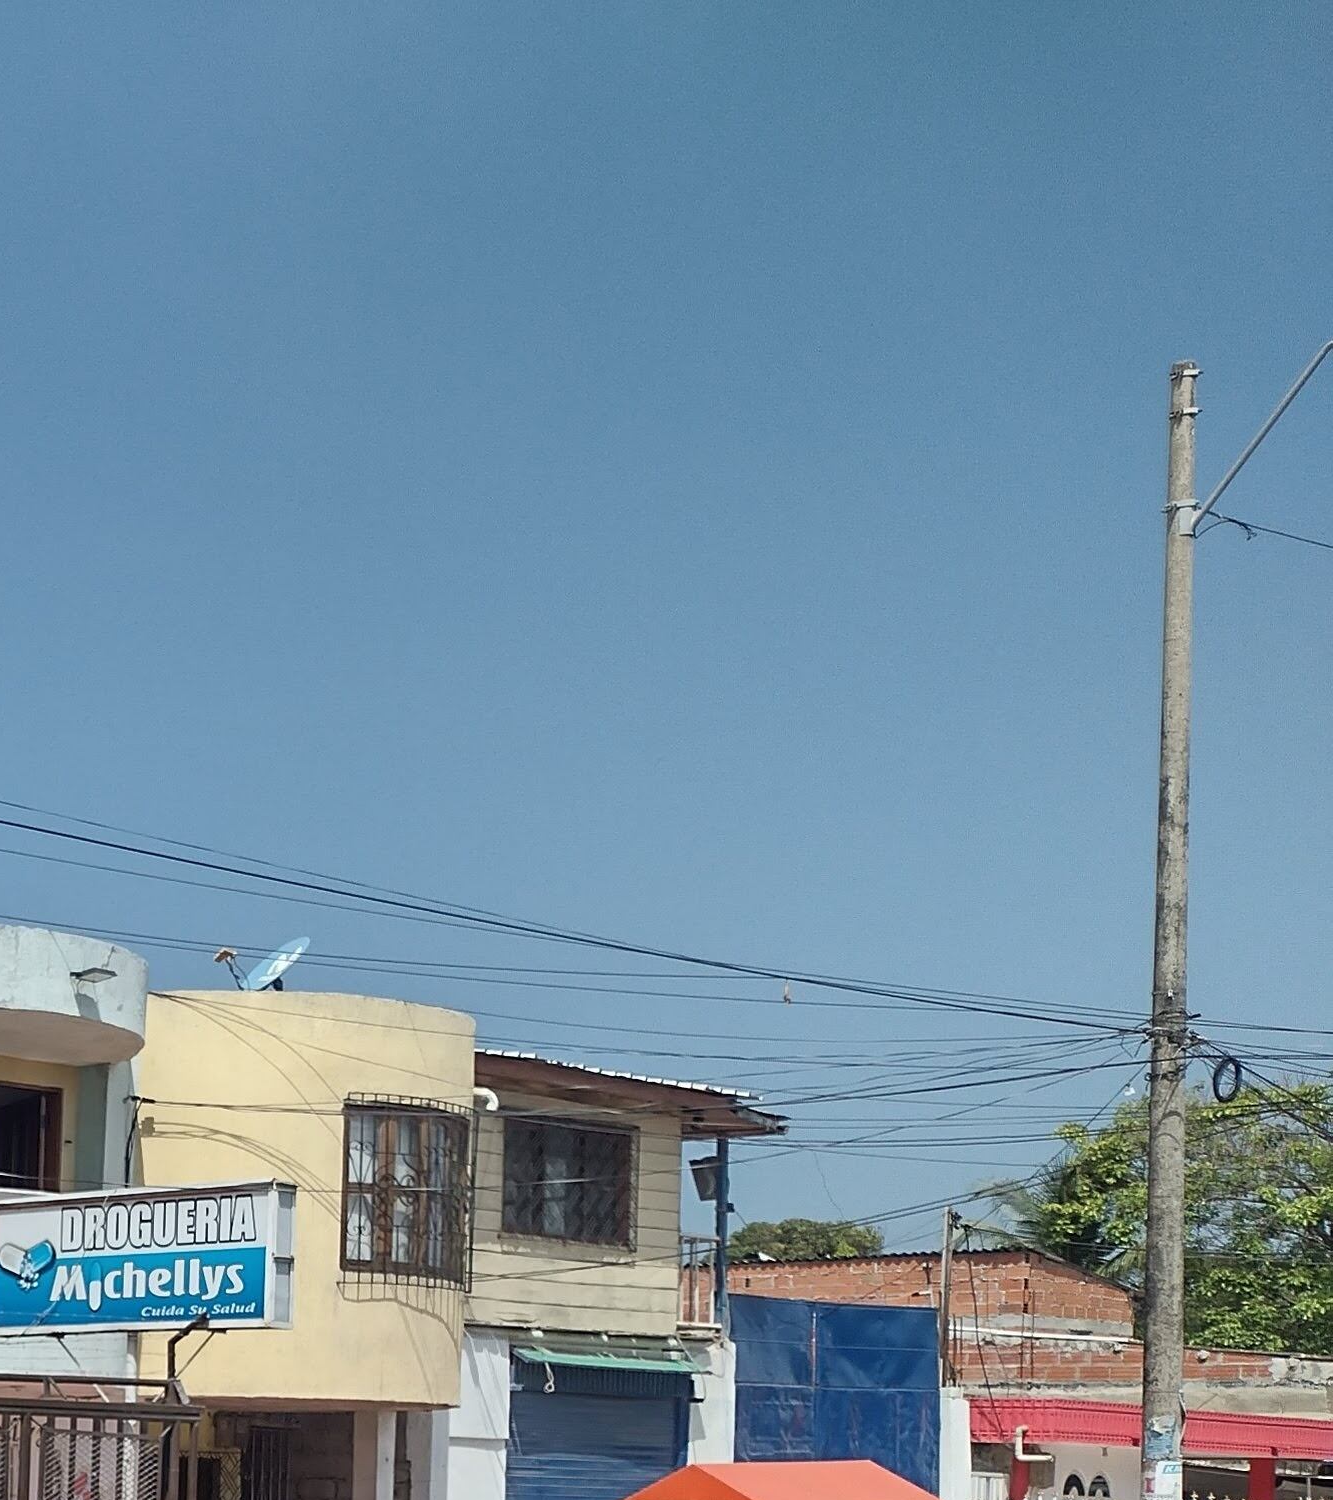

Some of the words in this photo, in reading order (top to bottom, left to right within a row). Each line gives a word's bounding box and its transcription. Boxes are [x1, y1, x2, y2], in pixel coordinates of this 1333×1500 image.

[61, 1194, 257, 1252] DROGUERIA
[49, 1258, 244, 1311] Michellys
[141, 1304, 184, 1318] Cuida
[188, 1303, 208, 1316] Su
[211, 1302, 256, 1316] Salud
